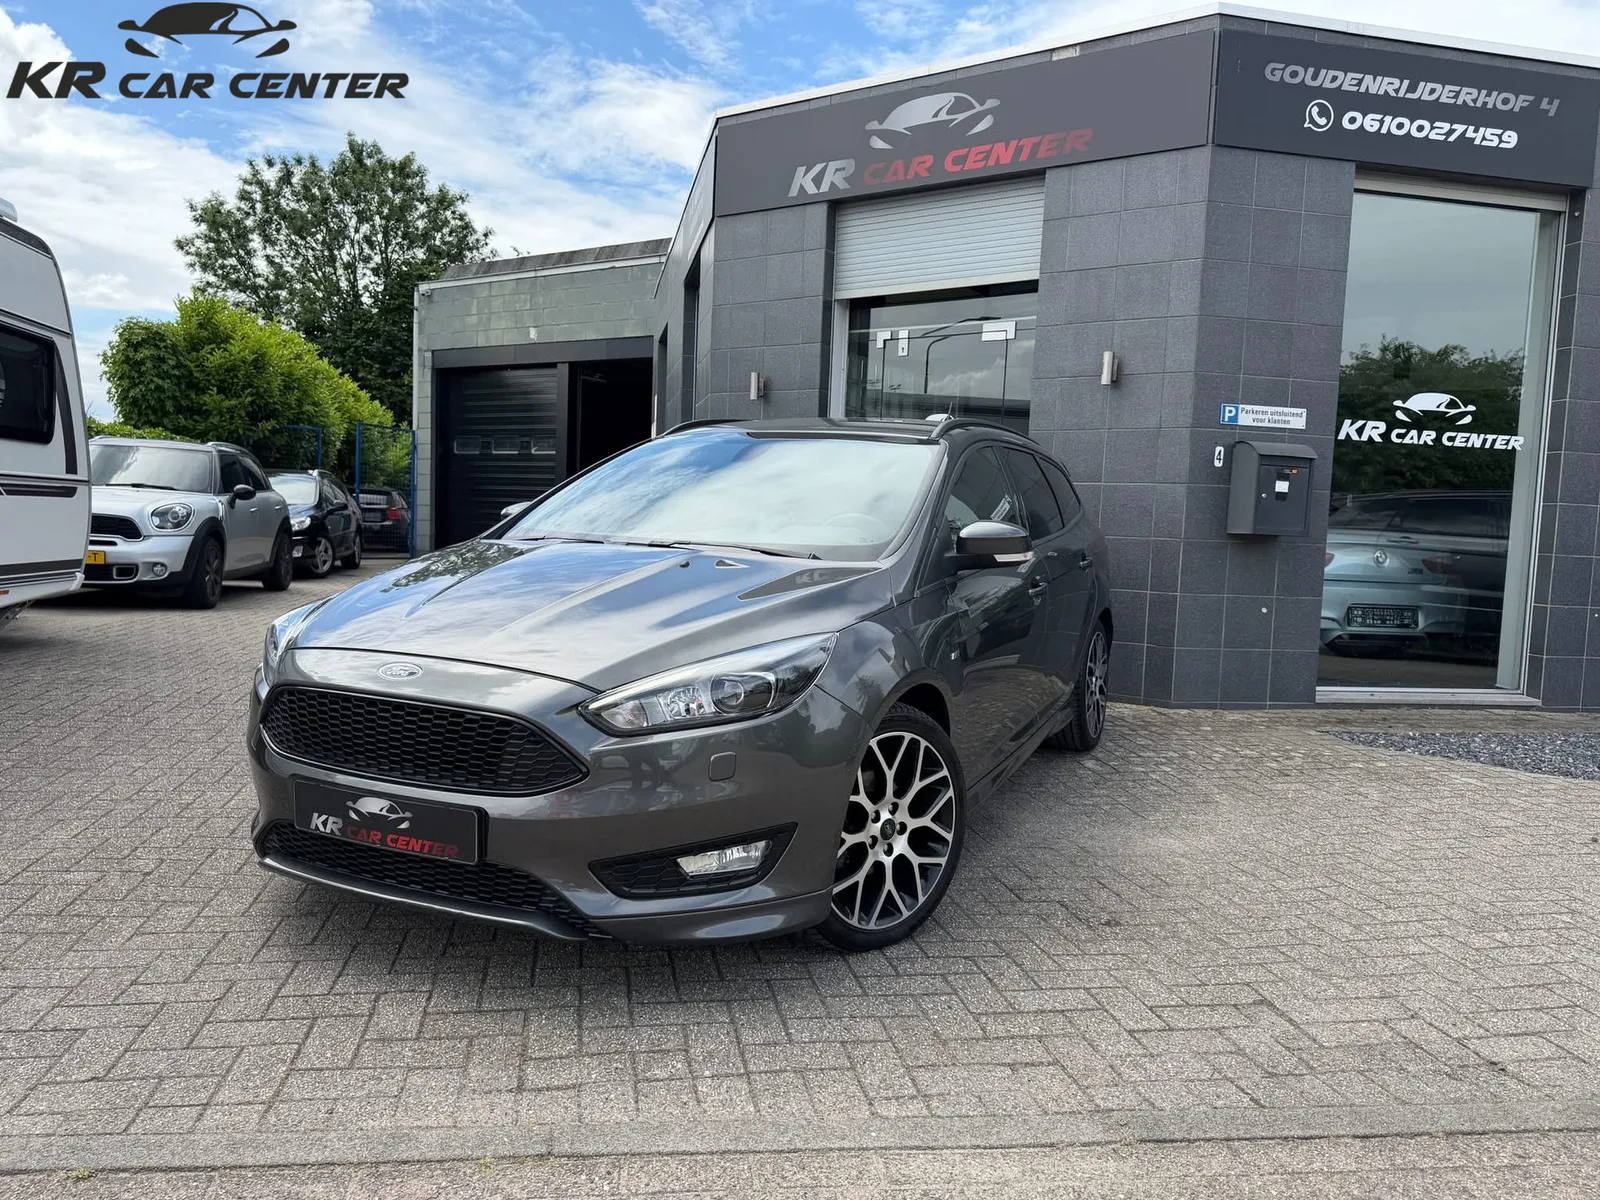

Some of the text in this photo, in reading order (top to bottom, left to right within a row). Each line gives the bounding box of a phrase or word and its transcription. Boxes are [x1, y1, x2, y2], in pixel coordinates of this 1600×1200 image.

[1264, 62, 1561, 117] GOUDENRIJDERHOF 4
[1341, 111, 1519, 149] 0610027459
[787, 128, 1094, 198] KR CAR CENTER
[1224, 406, 1237, 422] P
[1240, 407, 1269, 415] Parkeren
[1252, 416, 1291, 425] voor klanten
[1337, 419, 1525, 451] KR CAR CENTER
[1216, 449, 1222, 465] 4
[309, 812, 459, 857] KR CAR CENTER
